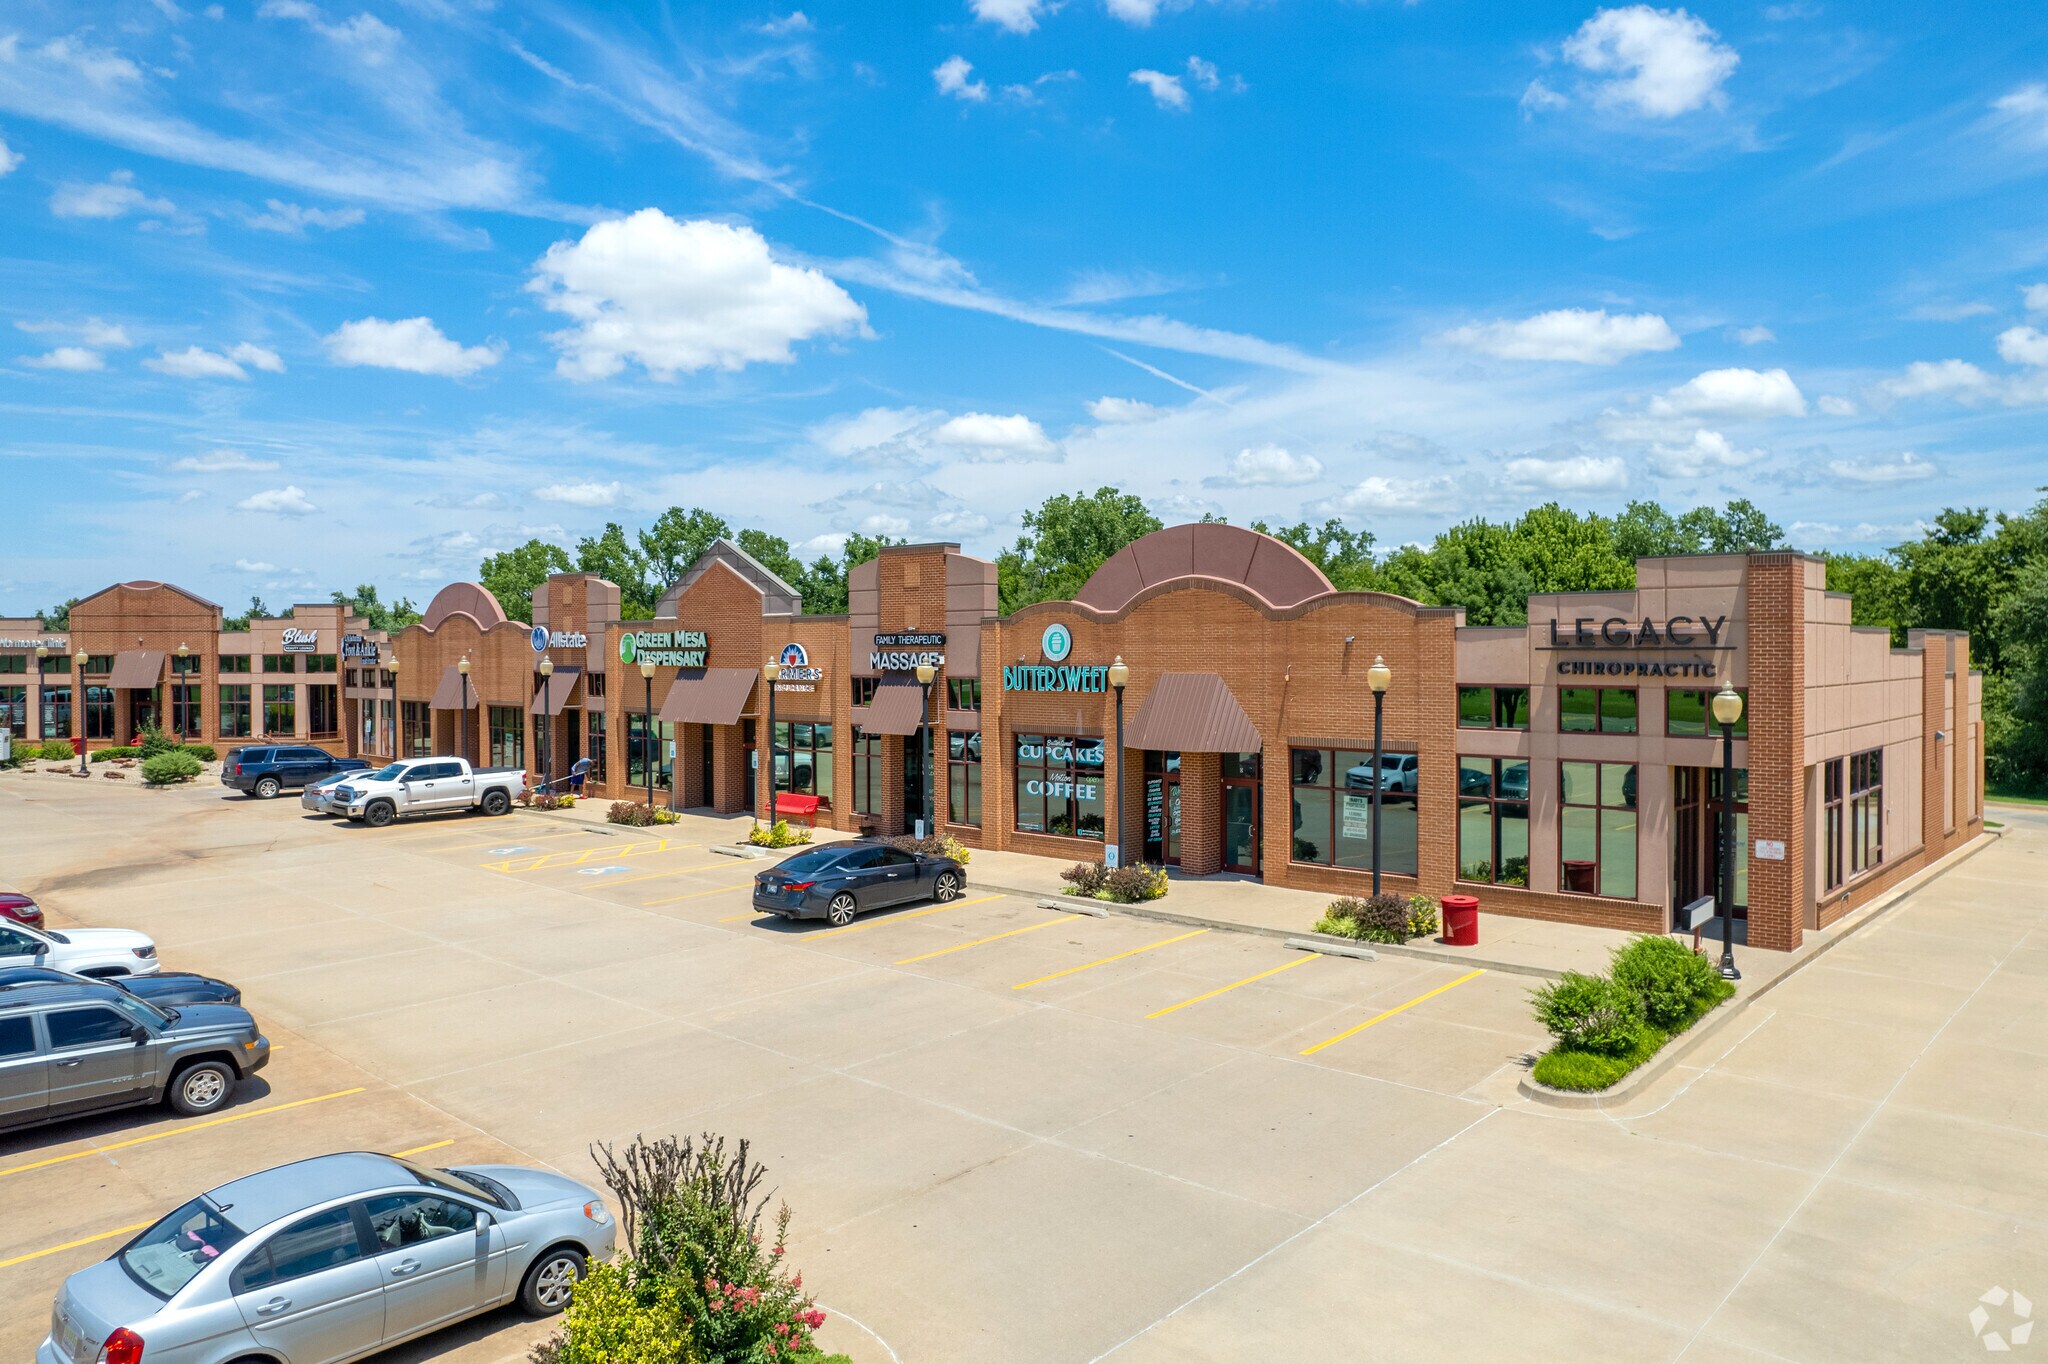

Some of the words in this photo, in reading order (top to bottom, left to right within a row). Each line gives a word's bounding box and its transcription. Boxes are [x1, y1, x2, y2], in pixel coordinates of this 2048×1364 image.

[281, 628, 318, 644] Blush
[549, 631, 587, 648] Allstate
[636, 630, 671, 648] GREEN
[675, 630, 707, 648] MESA
[1551, 615, 1726, 646] LEGACY
[875, 635, 896, 645] FAMILY
[898, 635, 942, 645] THERAPEUTIC
[1003, 665, 1108, 692] BUTTERSWEET
[1557, 661, 1717, 678] CHIROPRACTIC
[1019, 744, 1104, 763] CUPCAKES
[1026, 779, 1097, 800] COFFEE
